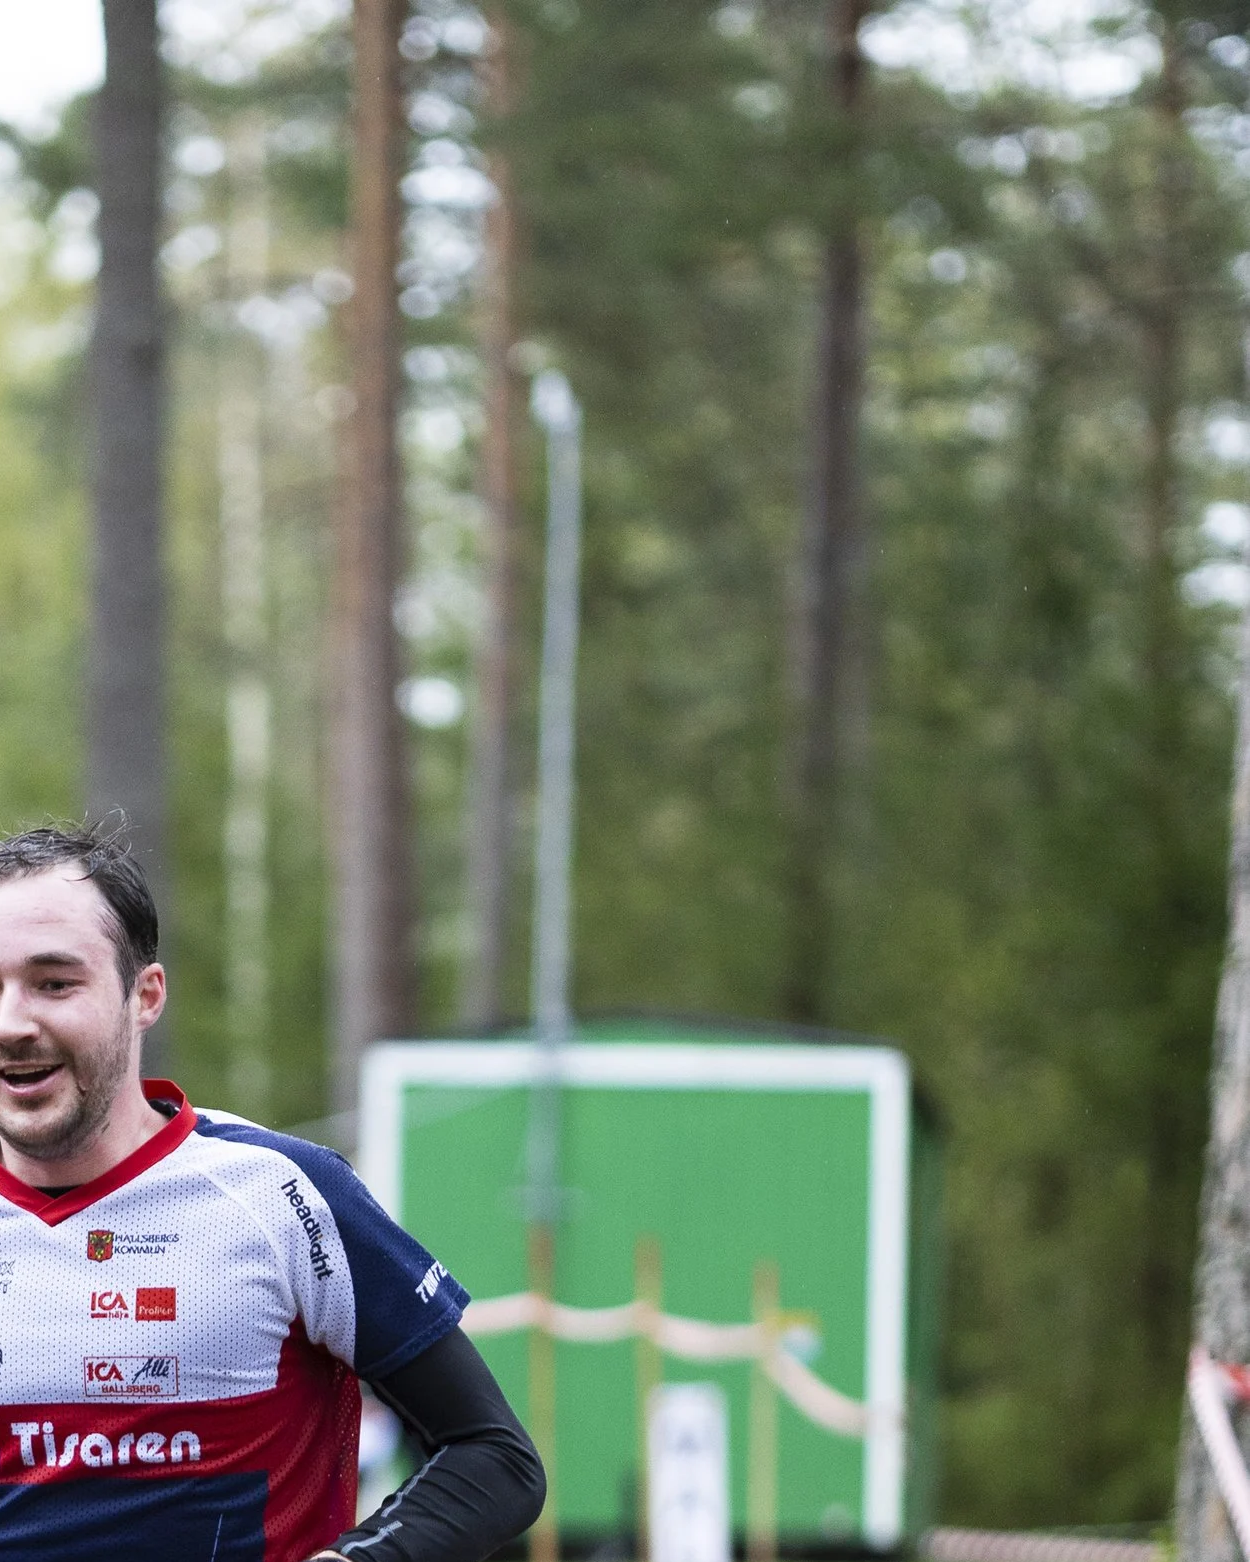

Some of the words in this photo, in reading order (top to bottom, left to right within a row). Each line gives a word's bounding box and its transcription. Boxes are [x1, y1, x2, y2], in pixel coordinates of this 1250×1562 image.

[115, 1234, 180, 1243] HALLSBERGS
[280, 1178, 334, 1281] headlight
[114, 1245, 165, 1255] KOMMUN
[90, 1290, 128, 1311] ICA
[88, 1362, 124, 1382] ICA
[132, 1357, 170, 1383] Allé
[102, 1384, 161, 1394] HALLSBERG
[11, 1421, 201, 1468] Tisaren
